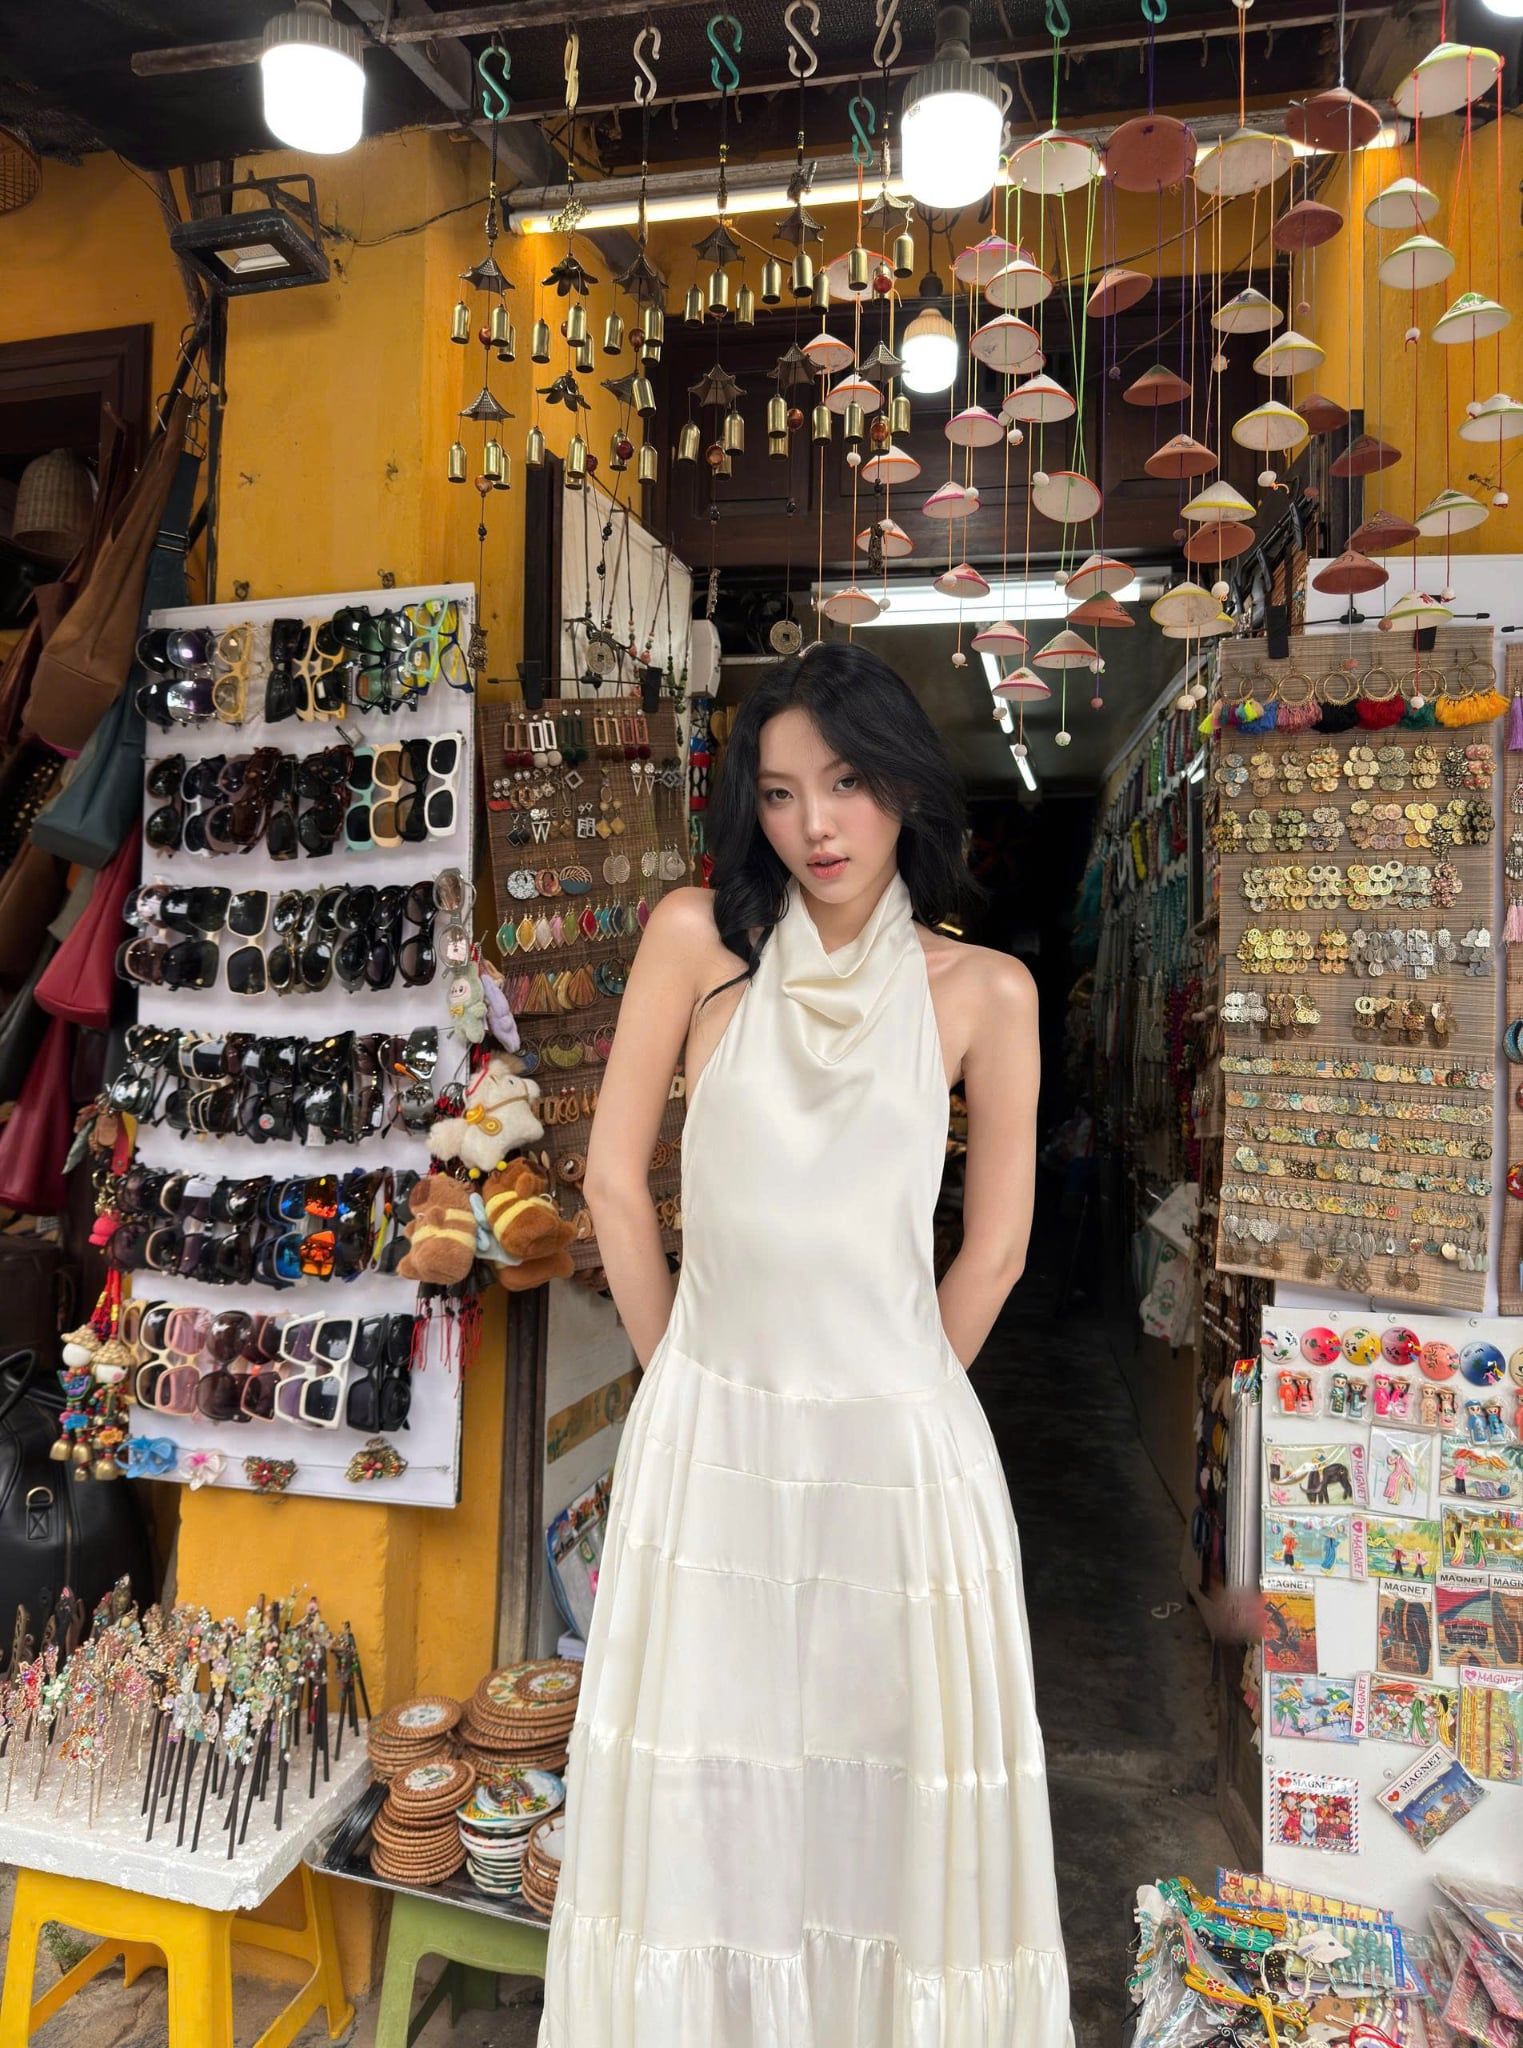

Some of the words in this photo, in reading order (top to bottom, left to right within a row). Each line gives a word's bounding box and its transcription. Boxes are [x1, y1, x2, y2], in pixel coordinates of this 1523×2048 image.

[1353, 1459, 1367, 1502] MAGNET
[1352, 1535, 1364, 1577] MAGNET
[1267, 1579, 1309, 1591] AGNET
[1384, 1582, 1427, 1595] MAGNET
[1440, 1574, 1483, 1585] MAGNET
[1477, 1671, 1522, 1685] MAGNET
[1356, 1677, 1368, 1720] MAGNET
[1399, 1752, 1441, 1792] MAGNET
